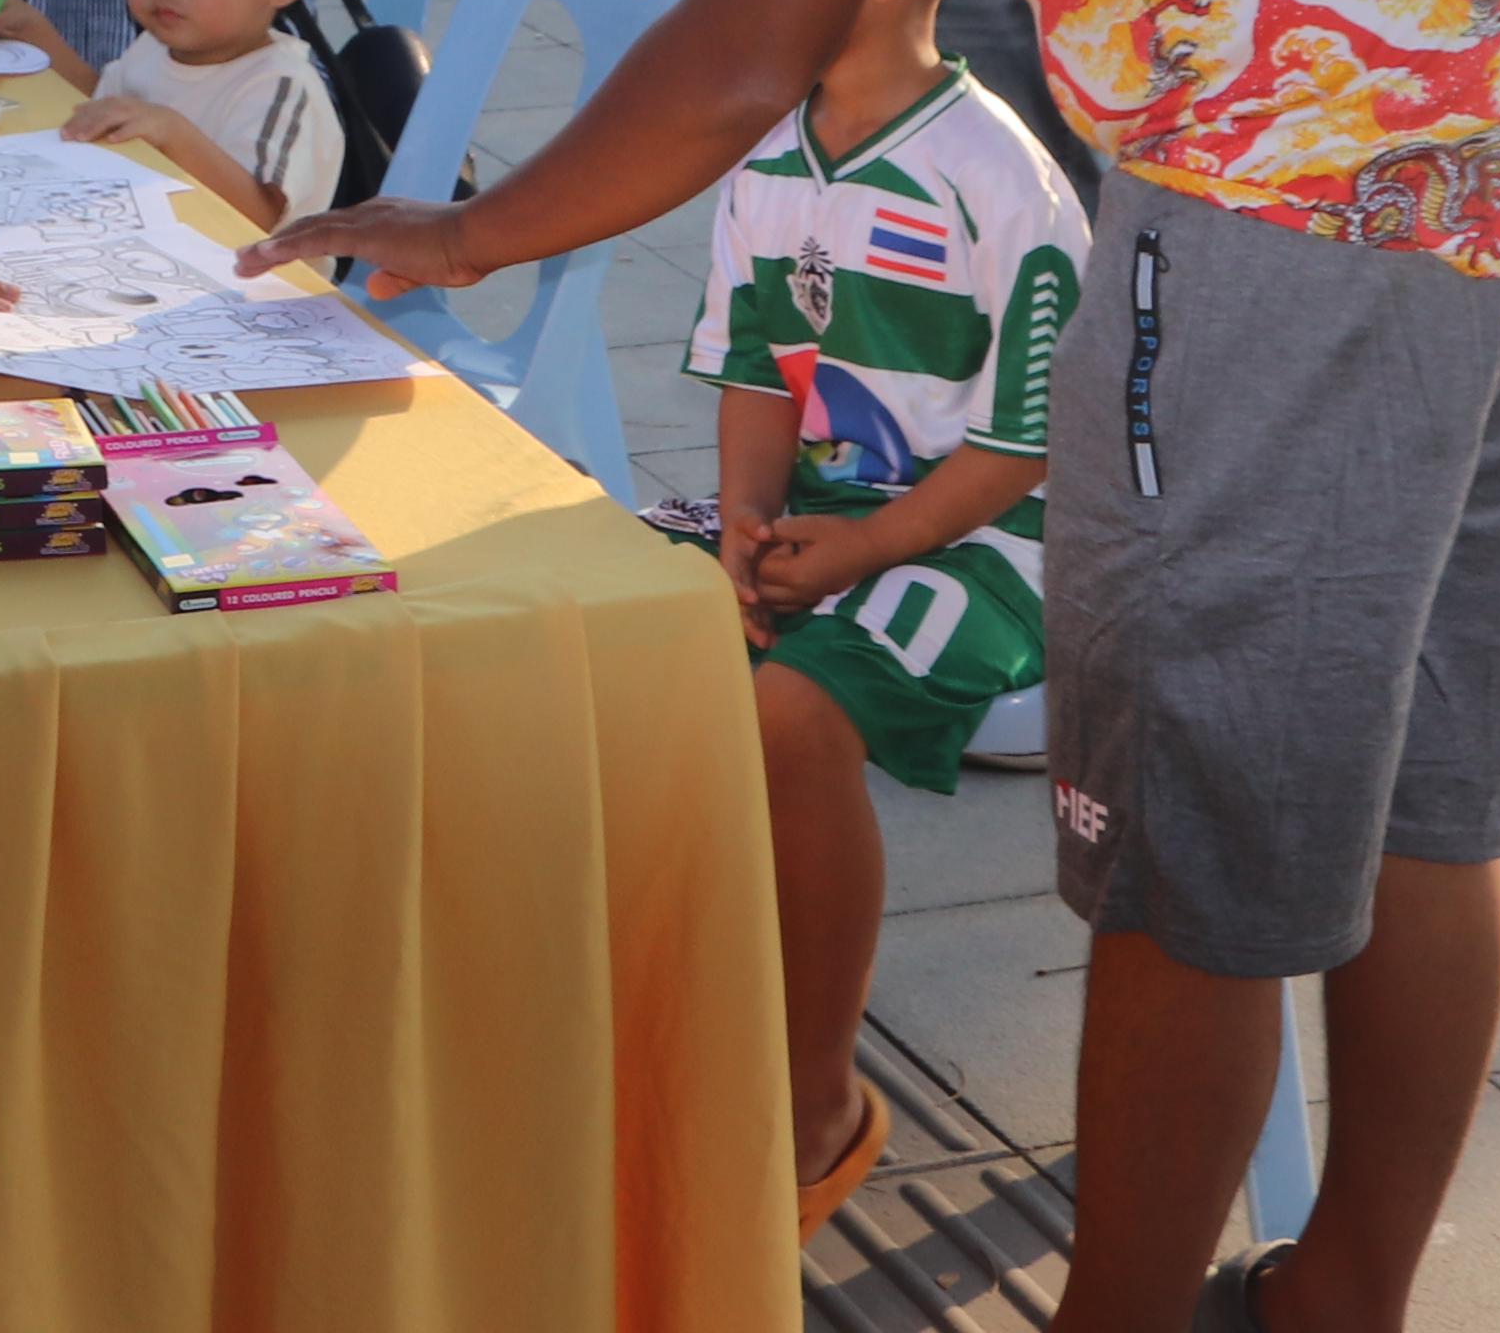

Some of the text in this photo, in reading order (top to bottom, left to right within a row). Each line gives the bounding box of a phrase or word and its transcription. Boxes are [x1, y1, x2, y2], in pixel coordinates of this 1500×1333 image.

[1132, 315, 1159, 436] SPORTS
[105, 437, 162, 452] COLOURED
[165, 434, 209, 447] PENCILS
[225, 595, 239, 605] 12
[241, 590, 296, 604] COLOURED
[299, 585, 339, 598] PENCILS
